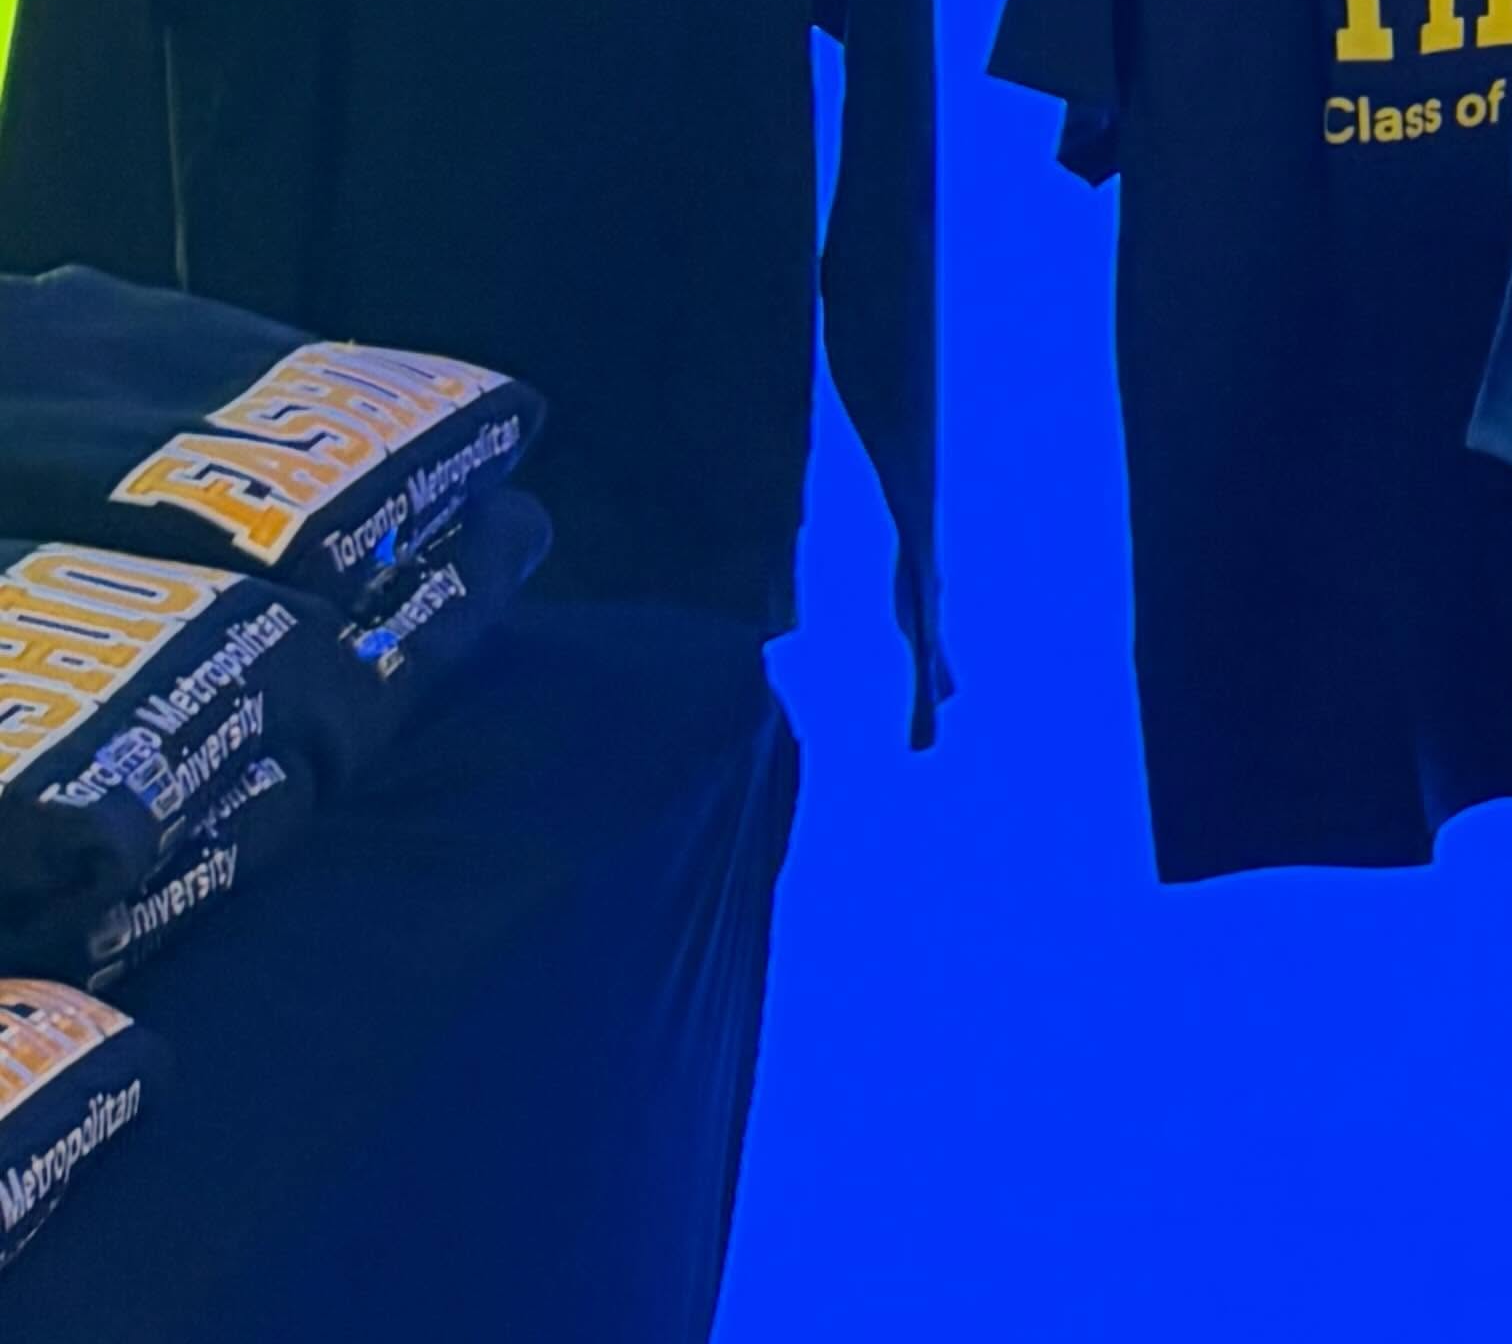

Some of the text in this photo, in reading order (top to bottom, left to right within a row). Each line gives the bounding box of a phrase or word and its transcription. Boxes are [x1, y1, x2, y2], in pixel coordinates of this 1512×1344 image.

[1323, 78, 1506, 144] Class of
[109, 341, 514, 566] FASHIO
[321, 491, 409, 572] Toronto
[406, 414, 521, 514] Metropolitan
[37, 725, 163, 809] Toroo
[134, 602, 298, 736] Metropolitan
[0, 1079, 141, 1230] Metropolitan
